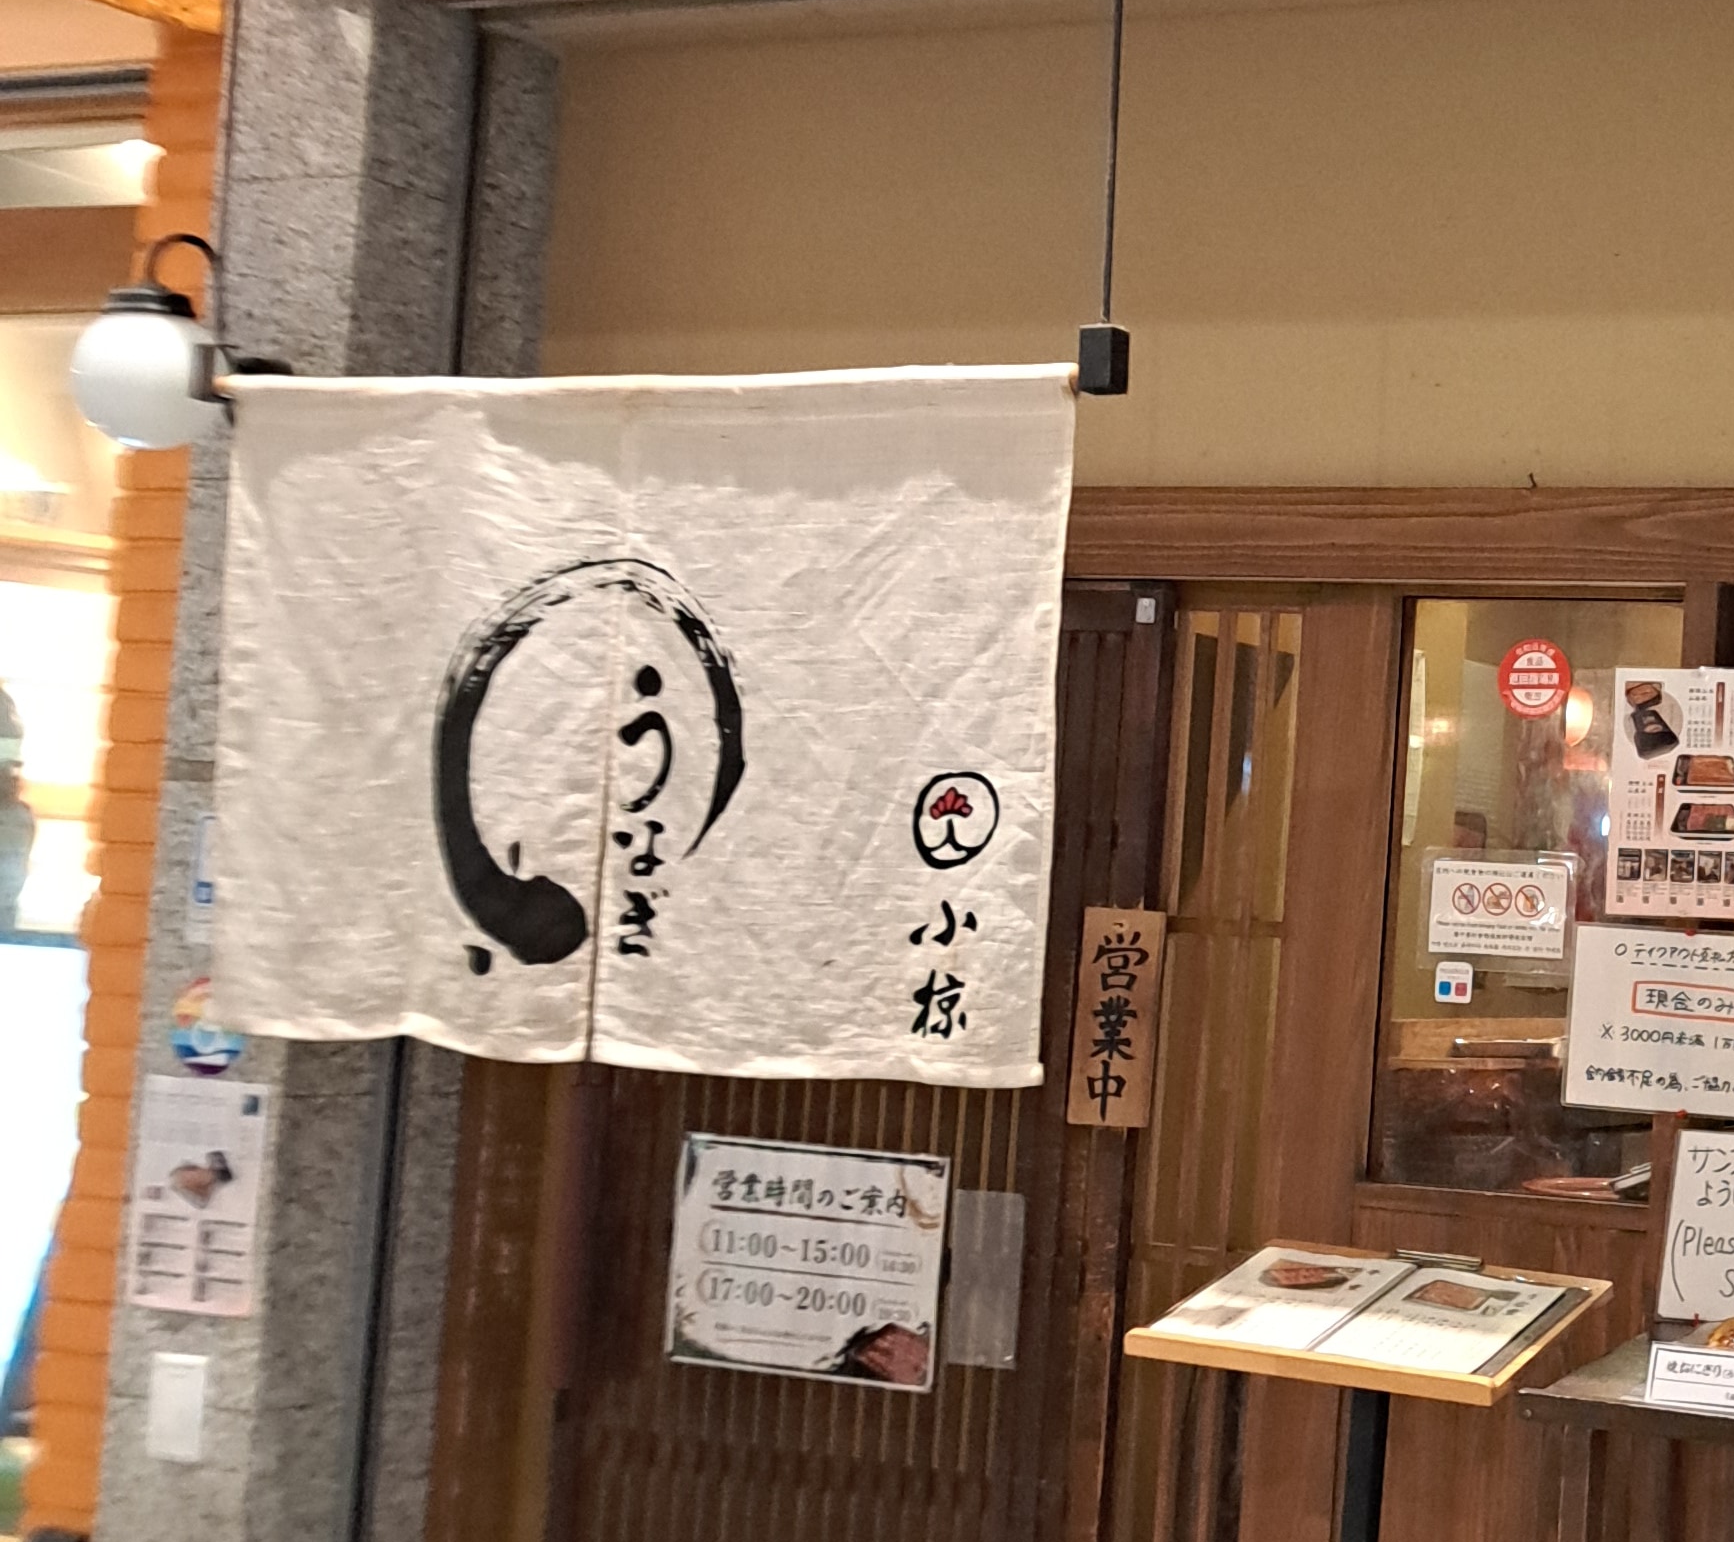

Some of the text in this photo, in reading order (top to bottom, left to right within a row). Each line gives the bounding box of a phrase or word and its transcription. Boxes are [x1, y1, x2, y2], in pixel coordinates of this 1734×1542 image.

[612, 664, 674, 956] うなぎ
[909, 900, 978, 1039] 小椋
[1086, 931, 1150, 1123] 営業中
[1645, 988, 1734, 1015] 現金のみ
[711, 1169, 908, 1219] 営業時間のご案内
